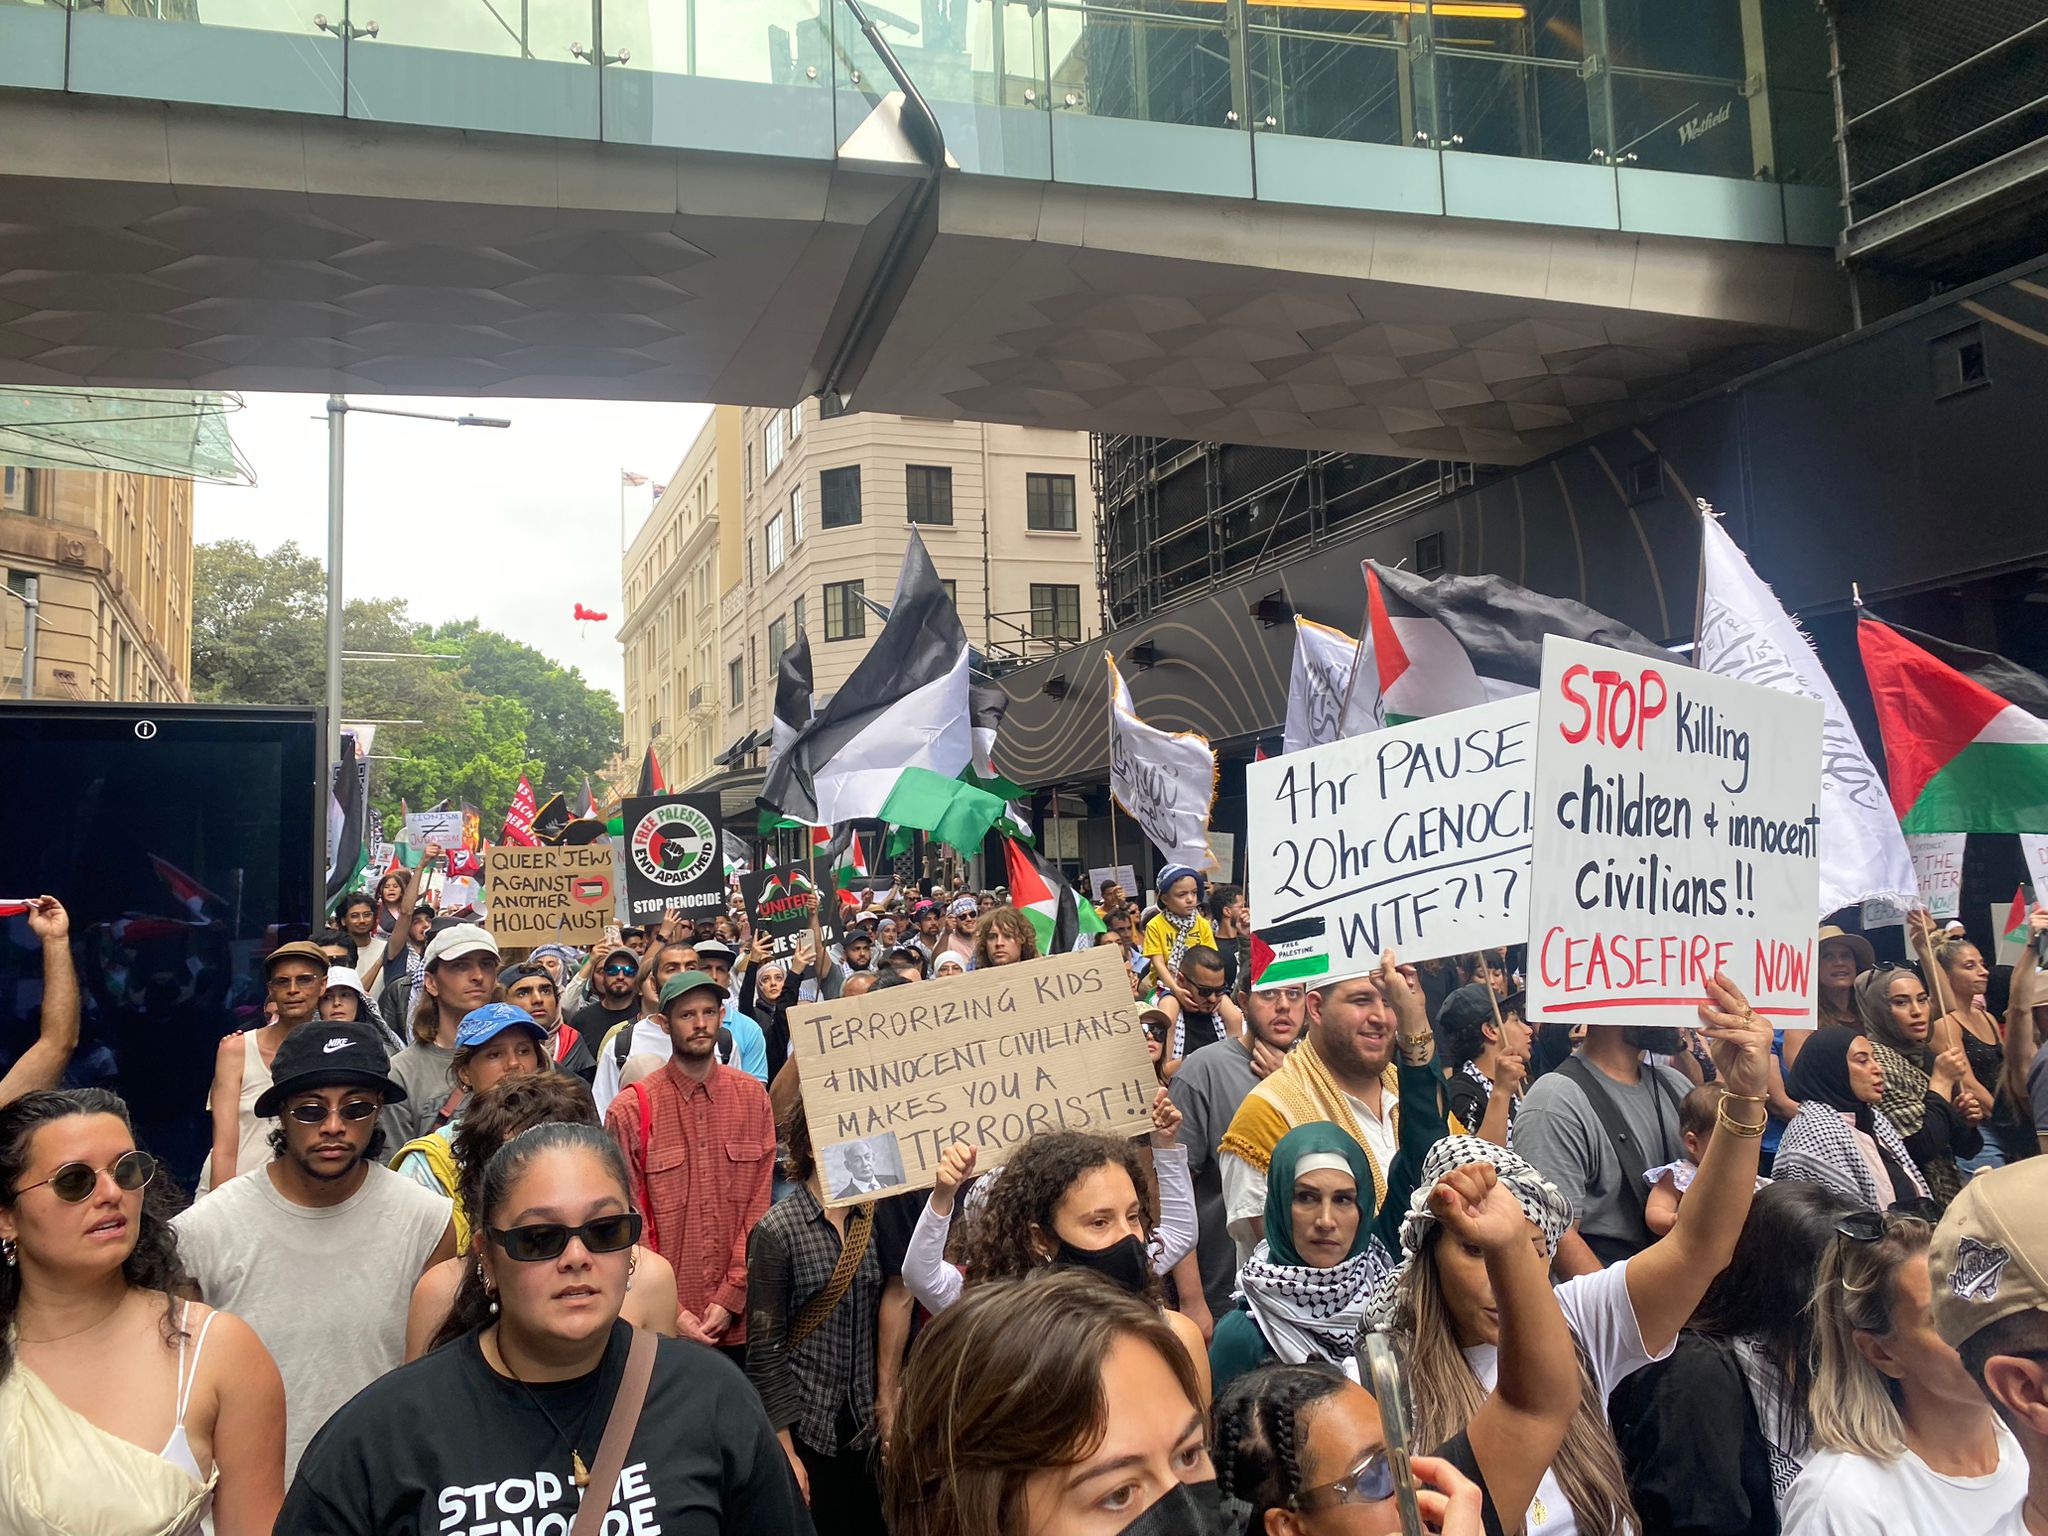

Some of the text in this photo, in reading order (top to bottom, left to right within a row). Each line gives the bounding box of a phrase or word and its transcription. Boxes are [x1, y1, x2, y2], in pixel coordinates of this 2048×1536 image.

[1678, 101, 1732, 146] Westfield
[1560, 664, 1667, 751] STOP
[1676, 692, 1750, 793] Killing
[1276, 721, 1531, 825] 4hr PAUSE
[411, 813, 459, 822] ZIONISM
[634, 816, 659, 846] FREE
[657, 806, 713, 840] PALESTINE
[1558, 764, 1691, 839] children
[1729, 801, 1820, 858] innocent
[492, 848, 612, 871] QUEER JEWS
[635, 848, 656, 875] END
[654, 841, 713, 884] APARTHEID
[1273, 829, 1376, 896] 20hr
[1384, 789, 1533, 864] GENOCI
[1925, 852, 1954, 871] THE
[492, 874, 579, 893] AGAINST
[492, 893, 571, 909] ANOTHER
[633, 892, 722, 914] STOP GENOCIDE
[759, 892, 810, 916] UNITED
[493, 909, 609, 932] HOLOCAUST
[1278, 946, 1314, 959] PALESTINE
[1541, 926, 1813, 998] CEASEFIRE NOW
[805, 968, 1104, 1055] TERRORIZING KIDS
[328, 1038, 349, 1047] NIKE
[999, 1009, 1132, 1058] CIVILIANS
[837, 1066, 1057, 1138] MAKES YOU A
[900, 1079, 1148, 1171] TERRORIST!!
[438, 1471, 563, 1531] STOP
